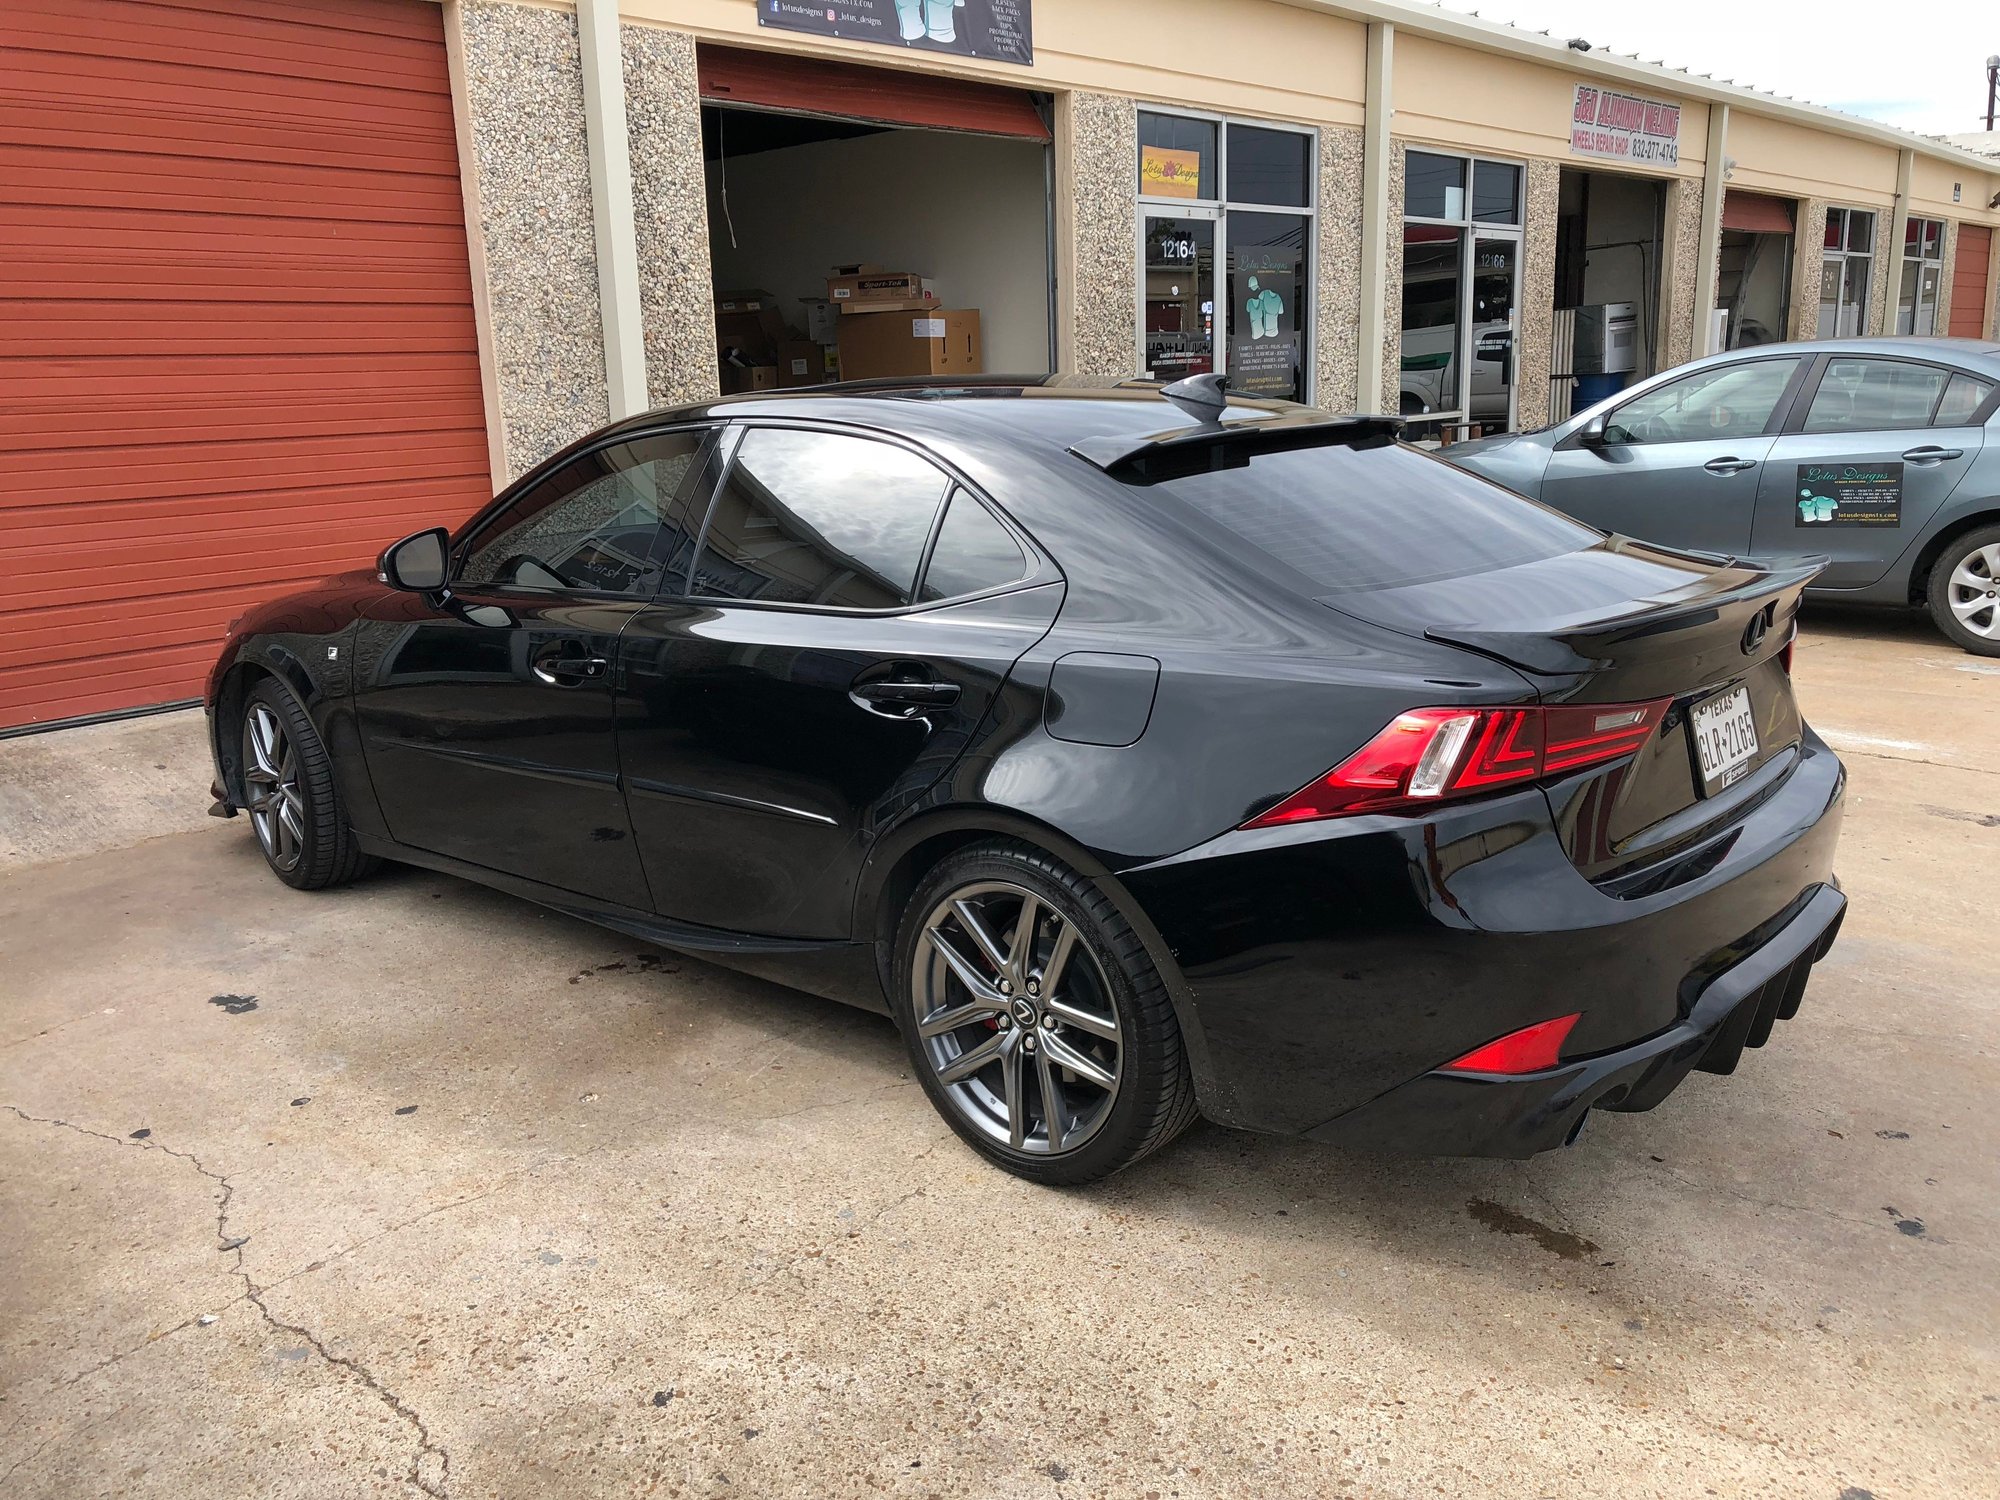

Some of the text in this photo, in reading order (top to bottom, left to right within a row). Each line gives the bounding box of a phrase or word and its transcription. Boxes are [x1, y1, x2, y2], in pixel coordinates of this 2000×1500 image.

[1597, 91, 1645, 133] ALUMINUM
[1643, 101, 1680, 139] WELDING
[1596, 133, 1614, 153] REPAIR
[1633, 138, 1677, 162] 832-277-4743
[1161, 240, 1197, 258] 12164
[1802, 466, 1888, 484] Lotus Designs
[1709, 693, 1733, 718] TEXAS
[1699, 711, 1755, 772] GLR 2165
